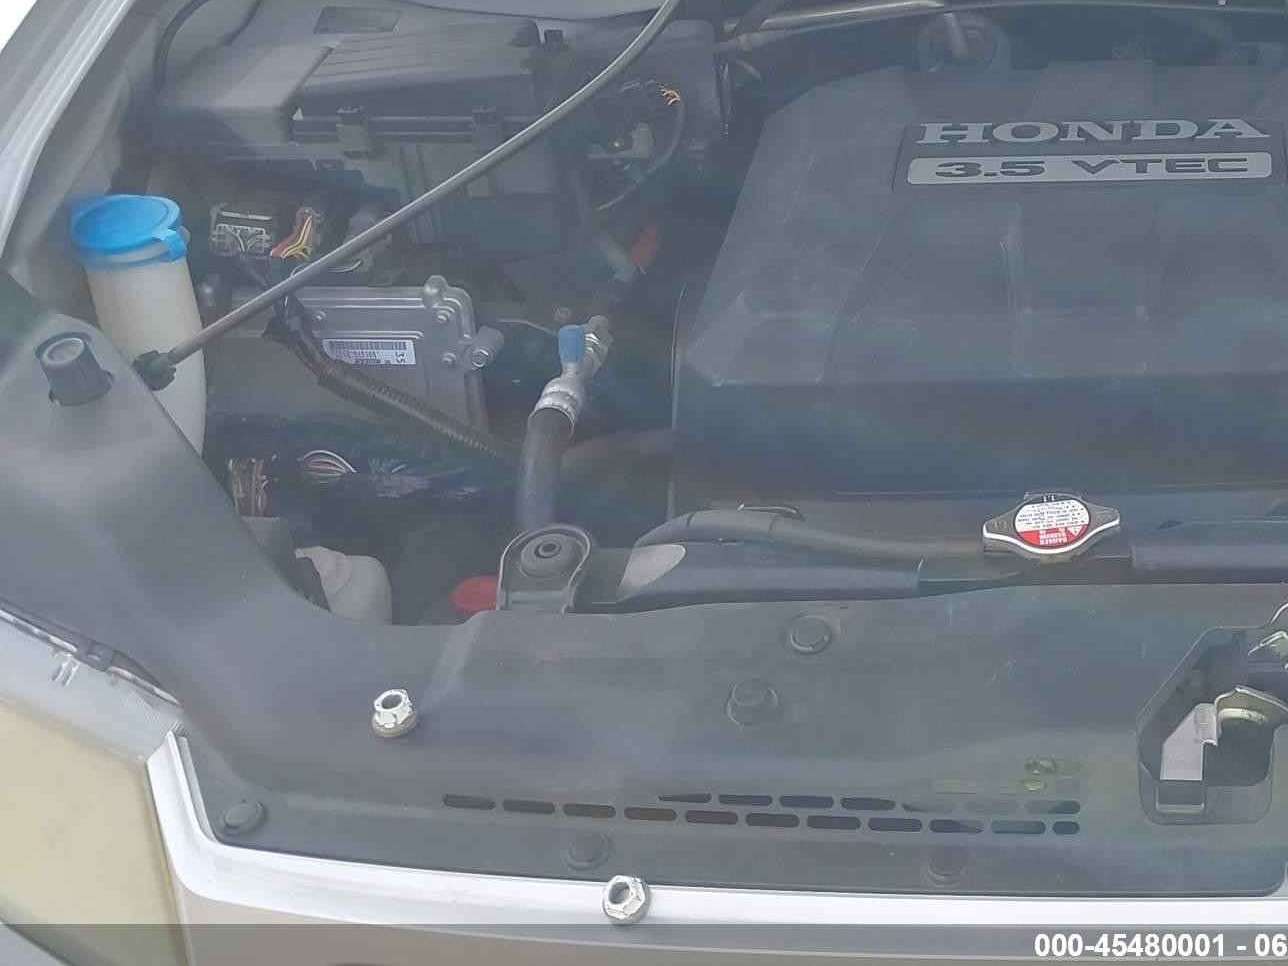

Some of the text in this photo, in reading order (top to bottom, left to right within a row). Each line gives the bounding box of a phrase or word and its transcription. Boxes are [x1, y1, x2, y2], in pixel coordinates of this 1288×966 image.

[917, 118, 1271, 144] HONDA
[935, 158, 1249, 177] 3.5 VTEC
[1039, 537, 1068, 545] DANGER
